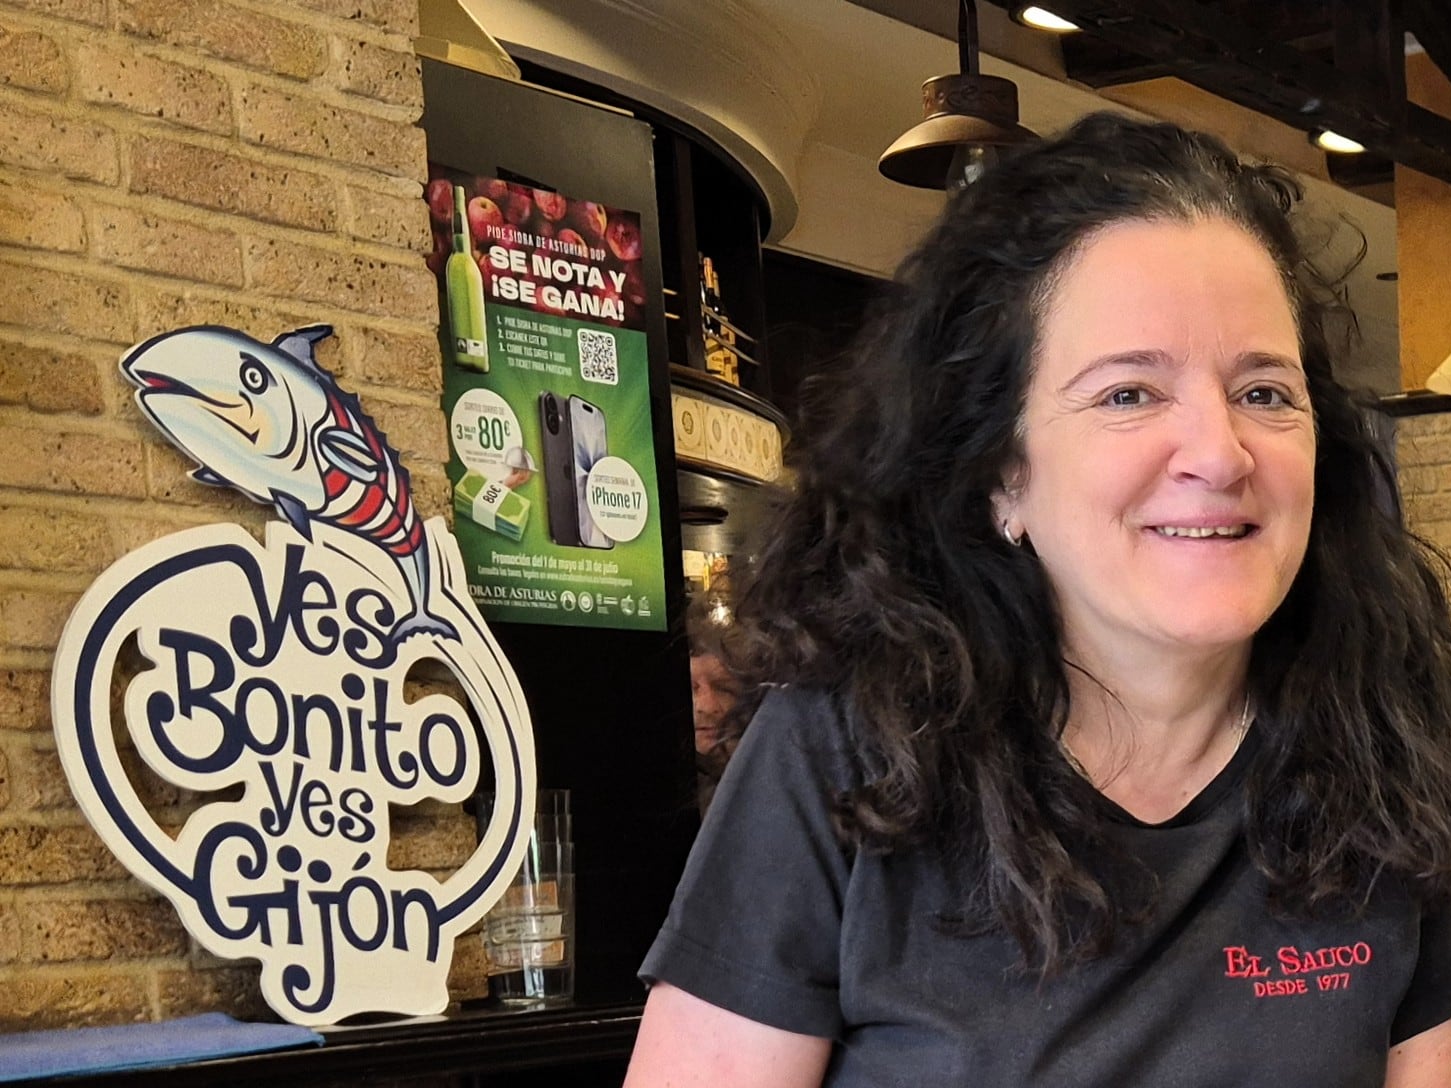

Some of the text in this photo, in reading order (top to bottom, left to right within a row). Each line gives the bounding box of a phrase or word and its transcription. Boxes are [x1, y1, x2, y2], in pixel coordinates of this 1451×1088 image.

[486, 224, 506, 239] PIDE
[508, 230, 534, 247] SIDRA
[536, 235, 547, 249] DE
[549, 239, 588, 259] ASTURIAS
[489, 245, 627, 293] SE NOTA Y
[491, 274, 625, 322] ¡SE GANA!
[456, 423, 463, 440] 3
[477, 415, 511, 451] 80€
[482, 484, 502, 504] 80€
[591, 485, 642, 510] iPhone 17
[469, 584, 557, 601] DRA DE ASTURIAS
[146, 627, 467, 790] Bonito
[192, 821, 440, 1013] Gijón
[1253, 973, 1351, 998] DESDE 1977
